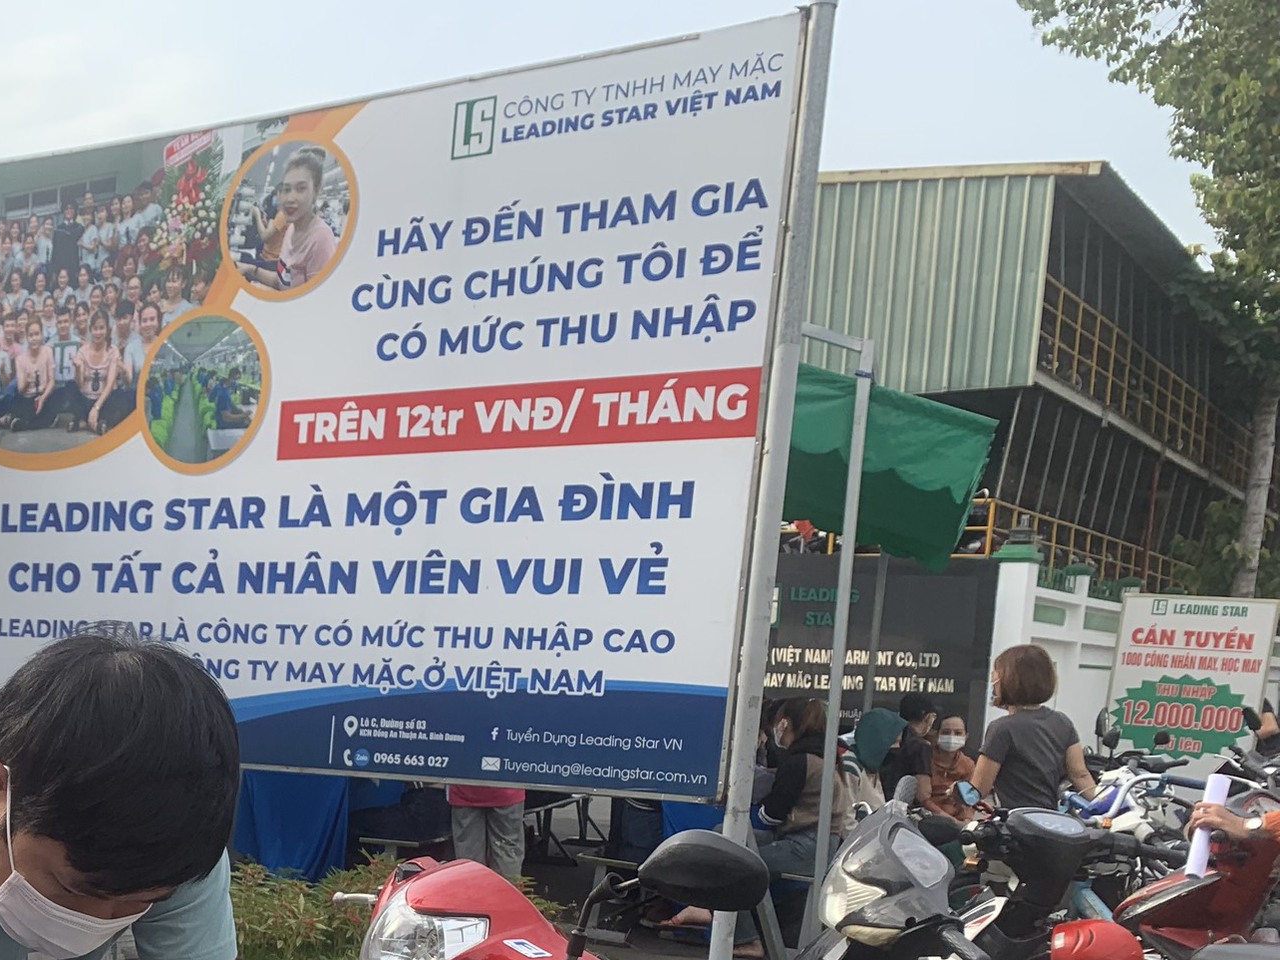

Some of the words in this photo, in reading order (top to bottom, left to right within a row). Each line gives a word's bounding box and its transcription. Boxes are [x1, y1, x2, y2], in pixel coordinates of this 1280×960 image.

[503, 94, 564, 119] CÔNG
[571, 88, 597, 108] TY
[603, 74, 665, 101] TNHH
[672, 64, 723, 88] MAY
[728, 52, 784, 83] MẶC
[501, 113, 596, 143] LEADING
[600, 103, 658, 128] STAR
[665, 89, 718, 118] VIỆT
[724, 80, 782, 107] NAM
[376, 216, 454, 257] HÃY
[462, 200, 544, 247] ĐẾN
[556, 190, 678, 235] THAM
[691, 178, 769, 214] GIA
[352, 270, 452, 313] CÙNG
[464, 256, 604, 300] CHÚNG
[617, 241, 687, 286] TÔI
[700, 225, 764, 276] ĐỂ
[376, 322, 428, 361] CÓ
[438, 315, 524, 357] MỨC
[536, 311, 618, 348] THU
[630, 293, 757, 344] NHẬP
[293, 403, 386, 446] TRÊN
[395, 404, 462, 440] 12tr
[473, 390, 582, 438] VNĐ/
[591, 377, 749, 427] THÁNG
[0, 495, 153, 536] LEADING
[163, 493, 267, 531] STAR
[278, 484, 333, 528] LÀ
[344, 480, 449, 538] MỘT
[458, 483, 544, 525] GIA
[558, 472, 696, 521] ĐÌNH
[7, 560, 81, 595] CHO
[91, 550, 161, 594] TẤT
[172, 552, 225, 595] CẢ
[237, 552, 359, 595] NHÂN
[373, 550, 481, 595] VIÊN
[496, 557, 582, 595] VUI
[599, 543, 669, 596] VẺ
[790, 586, 860, 603] LEADIG
[1173, 603, 1219, 616] LEADING
[1222, 605, 1249, 617] STAR
[805, 611, 837, 627] STA
[160, 616, 189, 642] LÀ
[197, 617, 268, 645] CÔNG
[276, 624, 308, 645] TY
[314, 619, 353, 647] CÓ
[361, 619, 425, 647] MỨC
[434, 626, 494, 650] THU
[503, 622, 593, 658] NHẬP
[603, 628, 675, 653] CAO
[247, 659, 278, 681] TY
[285, 661, 345, 684] MAY
[352, 657, 416, 694] MẶC
[422, 656, 448, 688] Ở
[455, 661, 521, 698] VIỆT
[528, 668, 605, 696] NAM
[1121, 652, 1142, 667] 1000
[1242, 659, 1263, 673] MAY
[874, 676, 897, 692] TAR
[927, 677, 954, 693] NAM
[1156, 683, 1180, 697] THU
[416, 720, 427, 730] 03
[1123, 700, 1244, 733] 12.000.000
[506, 727, 540, 743] Tuyển
[544, 731, 577, 746] Dụng
[580, 734, 631, 750] Leading
[634, 736, 660, 749] Star
[663, 738, 684, 751] VN
[373, 752, 401, 764] 0965
[403, 754, 425, 766] 663
[427, 755, 449, 768] 027
[503, 758, 708, 785] Tuyendung@leadingstar.com.vn
